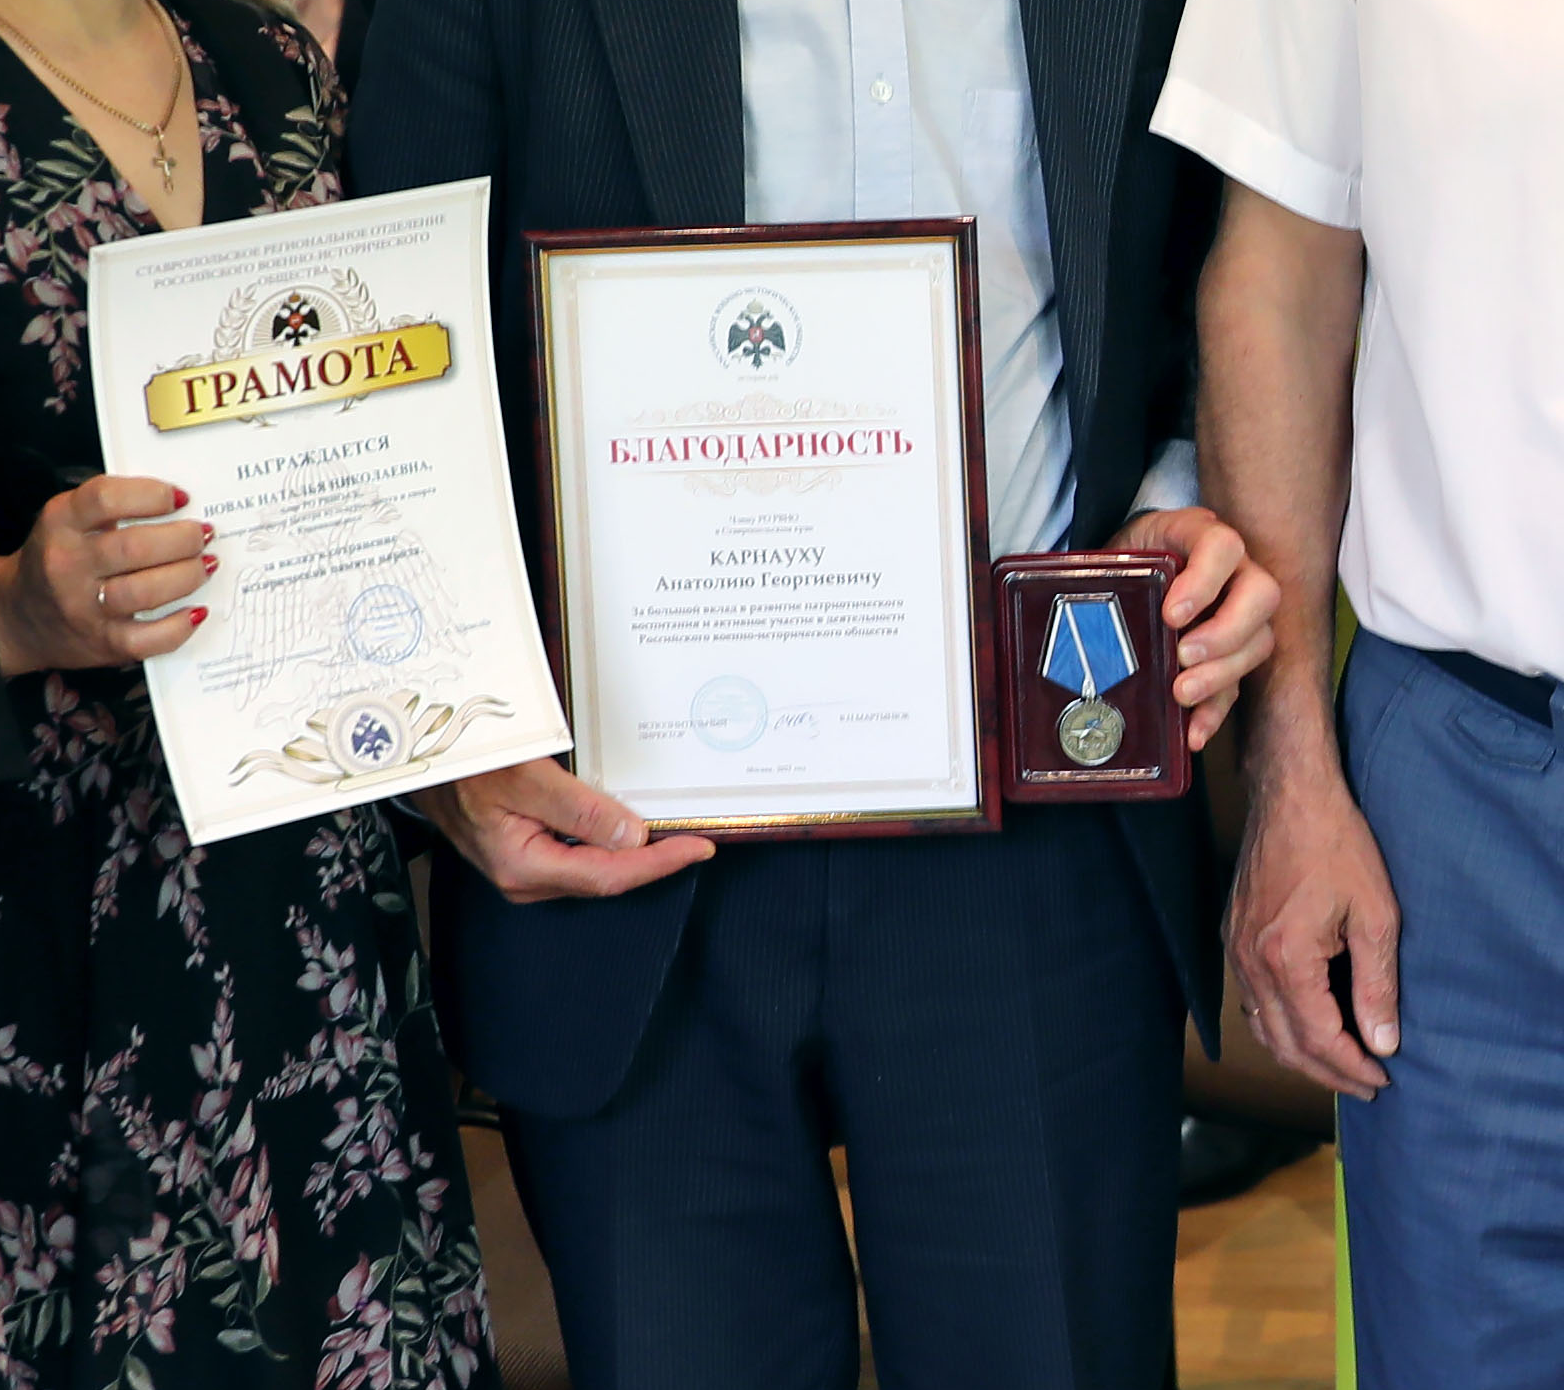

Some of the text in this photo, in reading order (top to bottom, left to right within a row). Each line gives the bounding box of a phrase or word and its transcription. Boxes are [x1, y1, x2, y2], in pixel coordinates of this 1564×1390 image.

[180, 337, 418, 414] ГРАМОТА
[237, 435, 390, 481] НАГРАЖДАЕТСЯ
[608, 429, 913, 467] БЛАГОДАРНОСТЬ
[710, 546, 826, 569] КАРНАУХУ
[655, 571, 883, 593] Анатолию Георгиевичу
